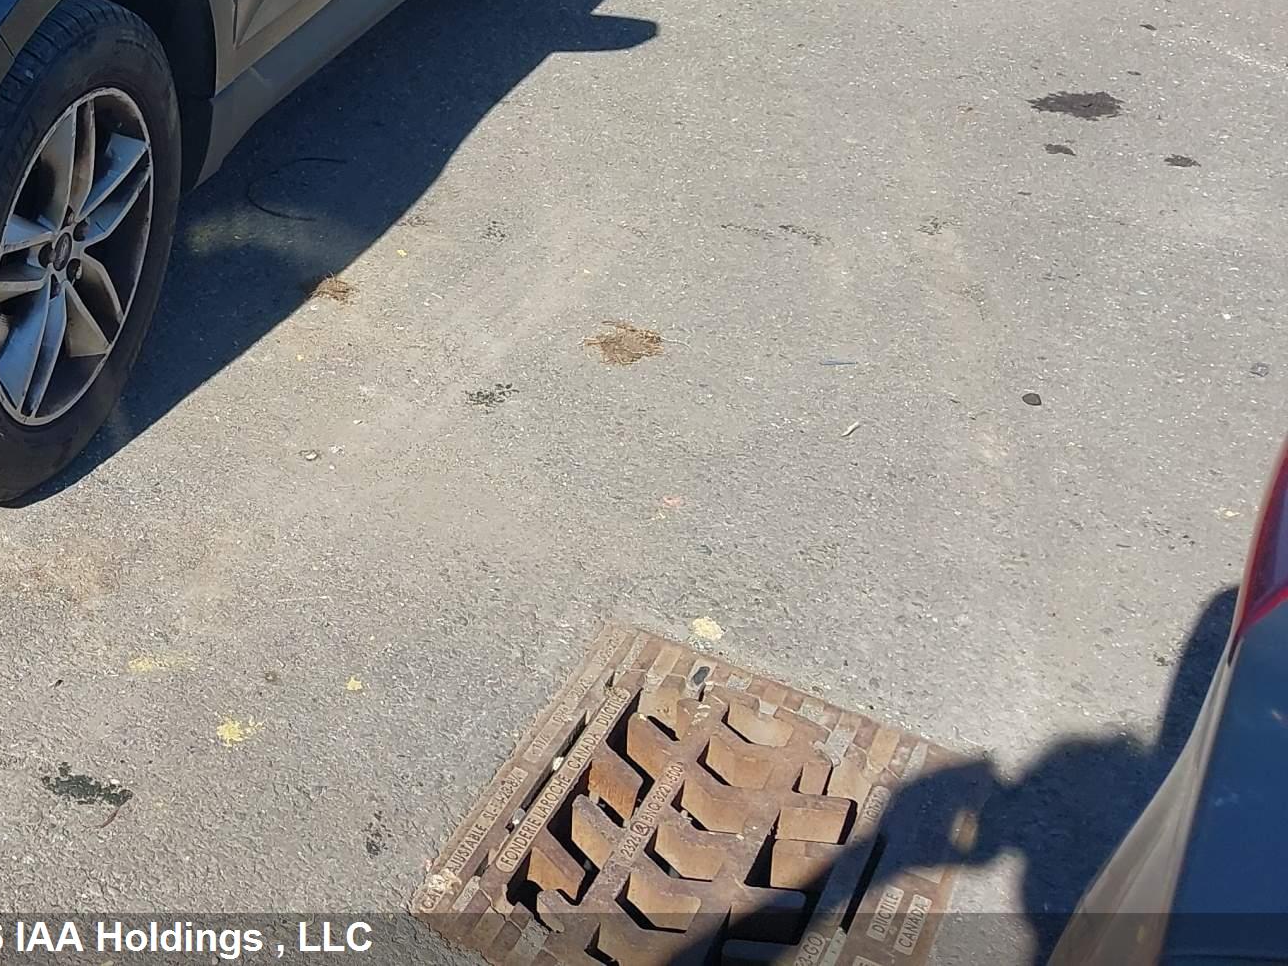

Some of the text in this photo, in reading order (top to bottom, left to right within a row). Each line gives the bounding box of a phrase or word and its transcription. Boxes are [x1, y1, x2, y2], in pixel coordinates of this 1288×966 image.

[500, 816, 542, 867] FONDERIE
[536, 773, 572, 820] LAROCHE
[567, 732, 602, 770] CANADA
[872, 892, 899, 934] DUCTILE
[898, 902, 929, 948] CANADA
